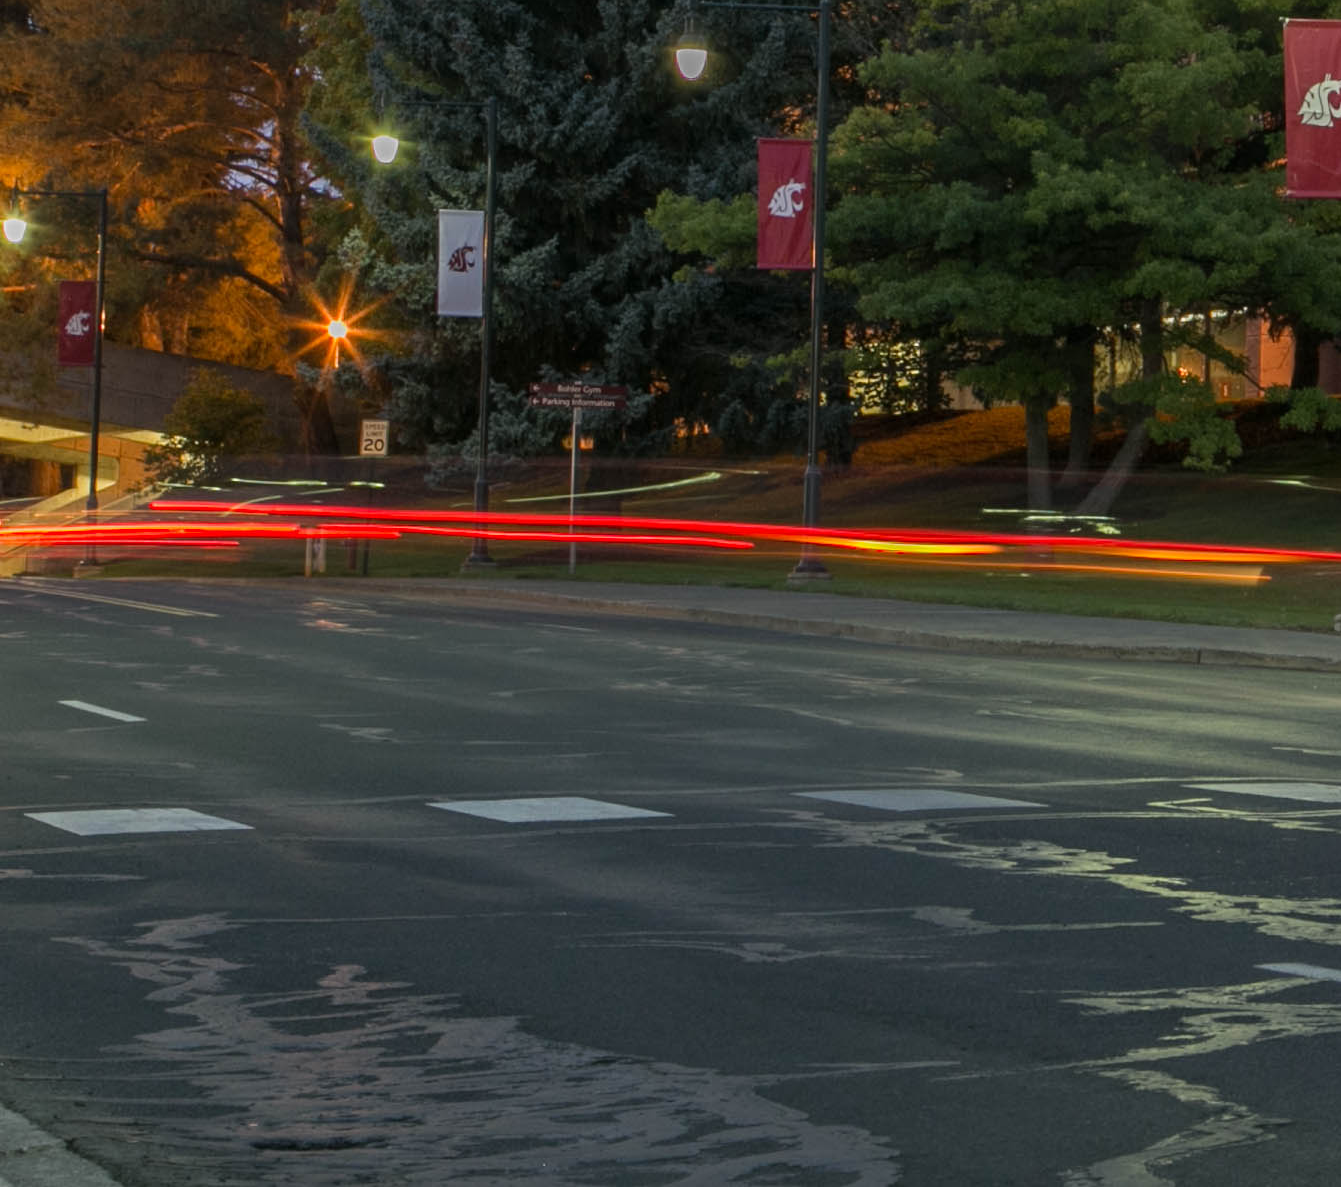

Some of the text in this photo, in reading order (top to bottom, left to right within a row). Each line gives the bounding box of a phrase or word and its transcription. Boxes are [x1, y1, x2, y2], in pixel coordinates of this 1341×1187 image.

[583, 385, 601, 395] Gym
[542, 397, 615, 407] Parking Information
[364, 438, 385, 452] 20
